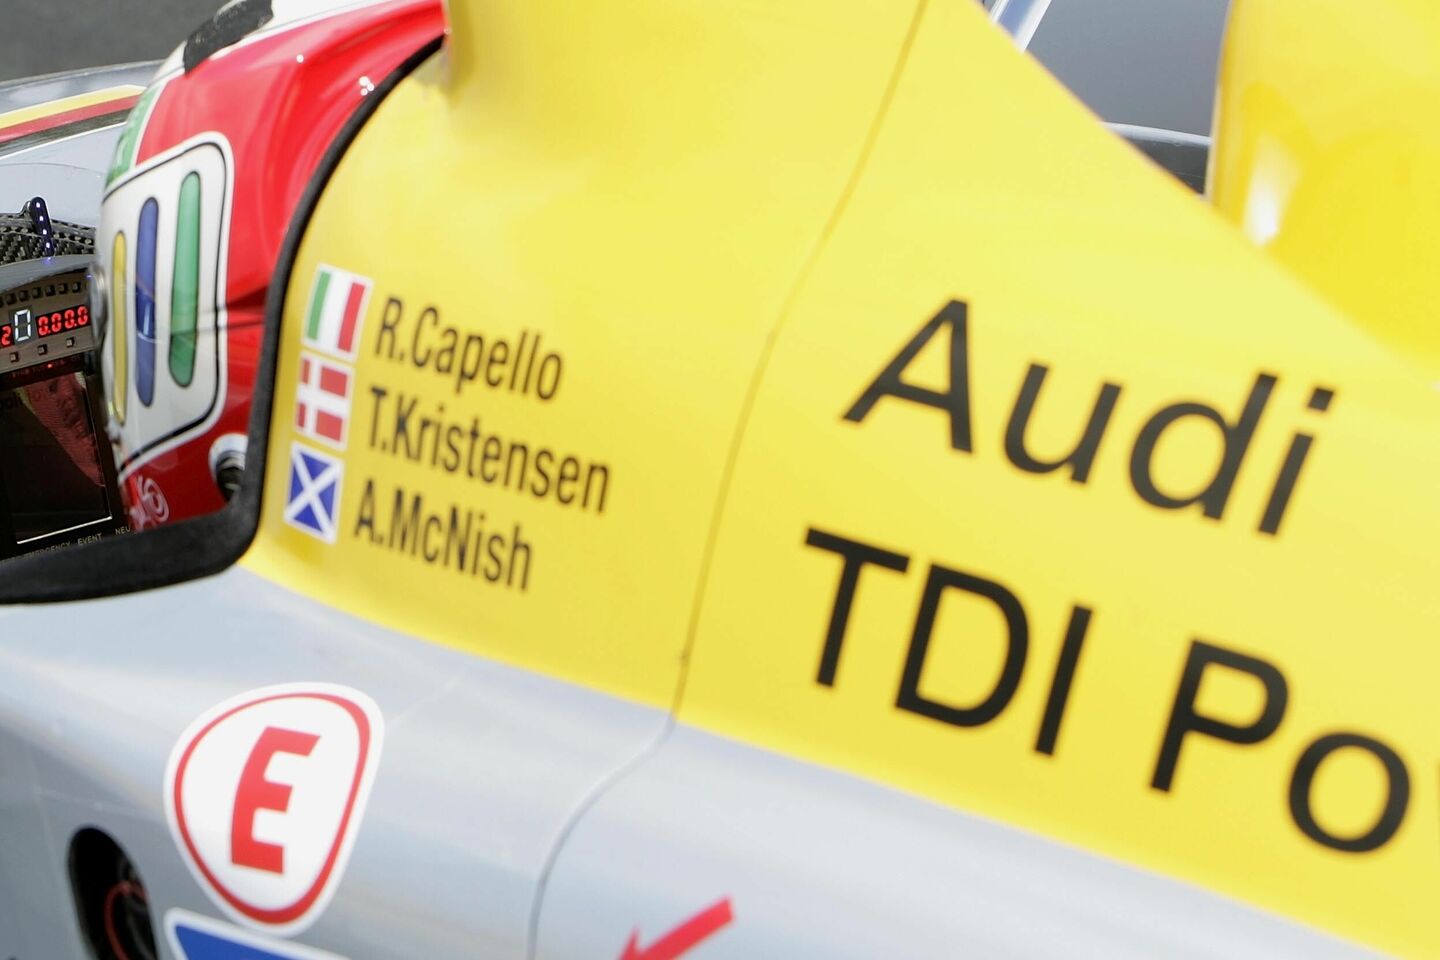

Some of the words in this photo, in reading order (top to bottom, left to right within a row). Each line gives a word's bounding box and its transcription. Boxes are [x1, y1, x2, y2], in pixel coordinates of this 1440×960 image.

[374, 296, 563, 401] R.Capello
[366, 385, 610, 515] T.Kristensen
[840, 298, 1336, 537] Audi
[77, 532, 103, 546] EVENT
[115, 526, 132, 536] NEU
[354, 480, 533, 592] A.McNish
[803, 526, 1094, 758] TDI
[1149, 636, 1440, 856] Po
[229, 725, 322, 876] E
